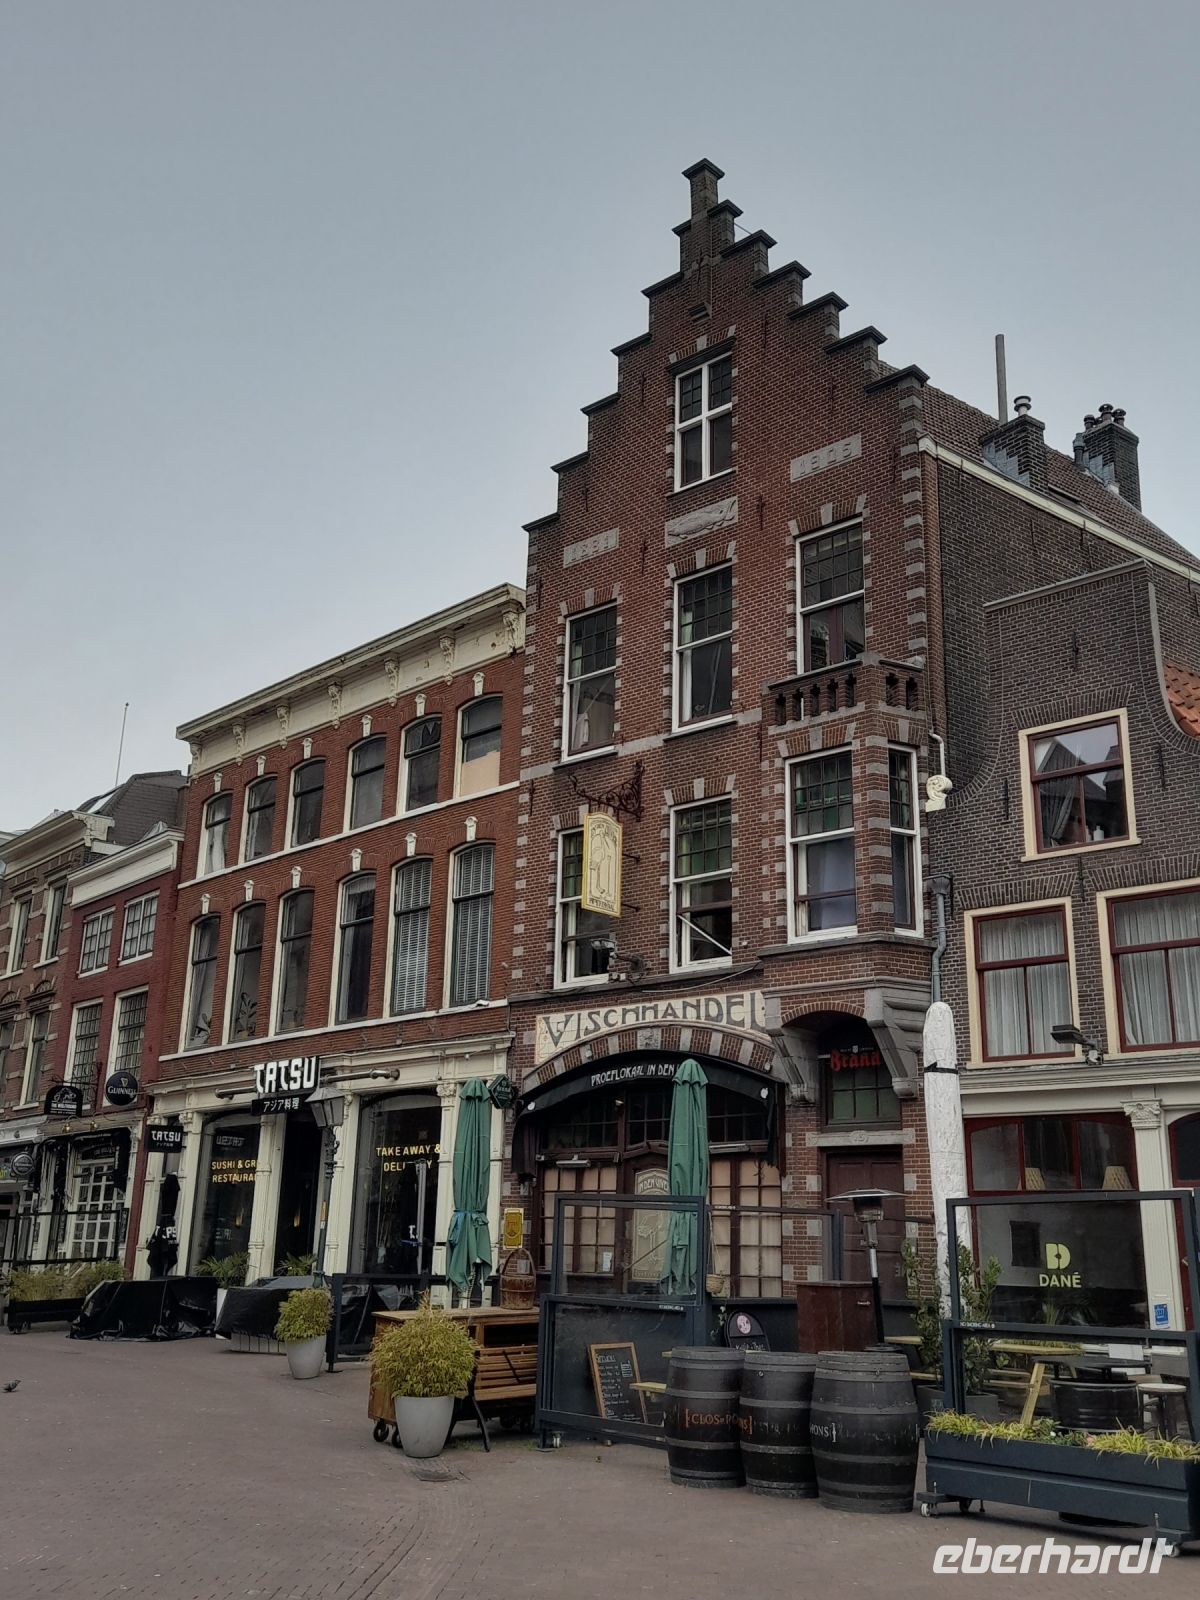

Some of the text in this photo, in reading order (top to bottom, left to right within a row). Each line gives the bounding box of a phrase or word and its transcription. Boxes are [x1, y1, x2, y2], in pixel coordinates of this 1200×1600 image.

[254, 1057, 315, 1093] TATSU
[658, 1064, 675, 1076] DEN
[151, 1130, 181, 1142] TATSU
[376, 1146, 401, 1157] TAKE
[403, 1145, 430, 1156] AWAY
[211, 1160, 236, 1170] SUSHI
[237, 1159, 243, 1169] &
[1039, 1272, 1082, 1289] DANÉ
